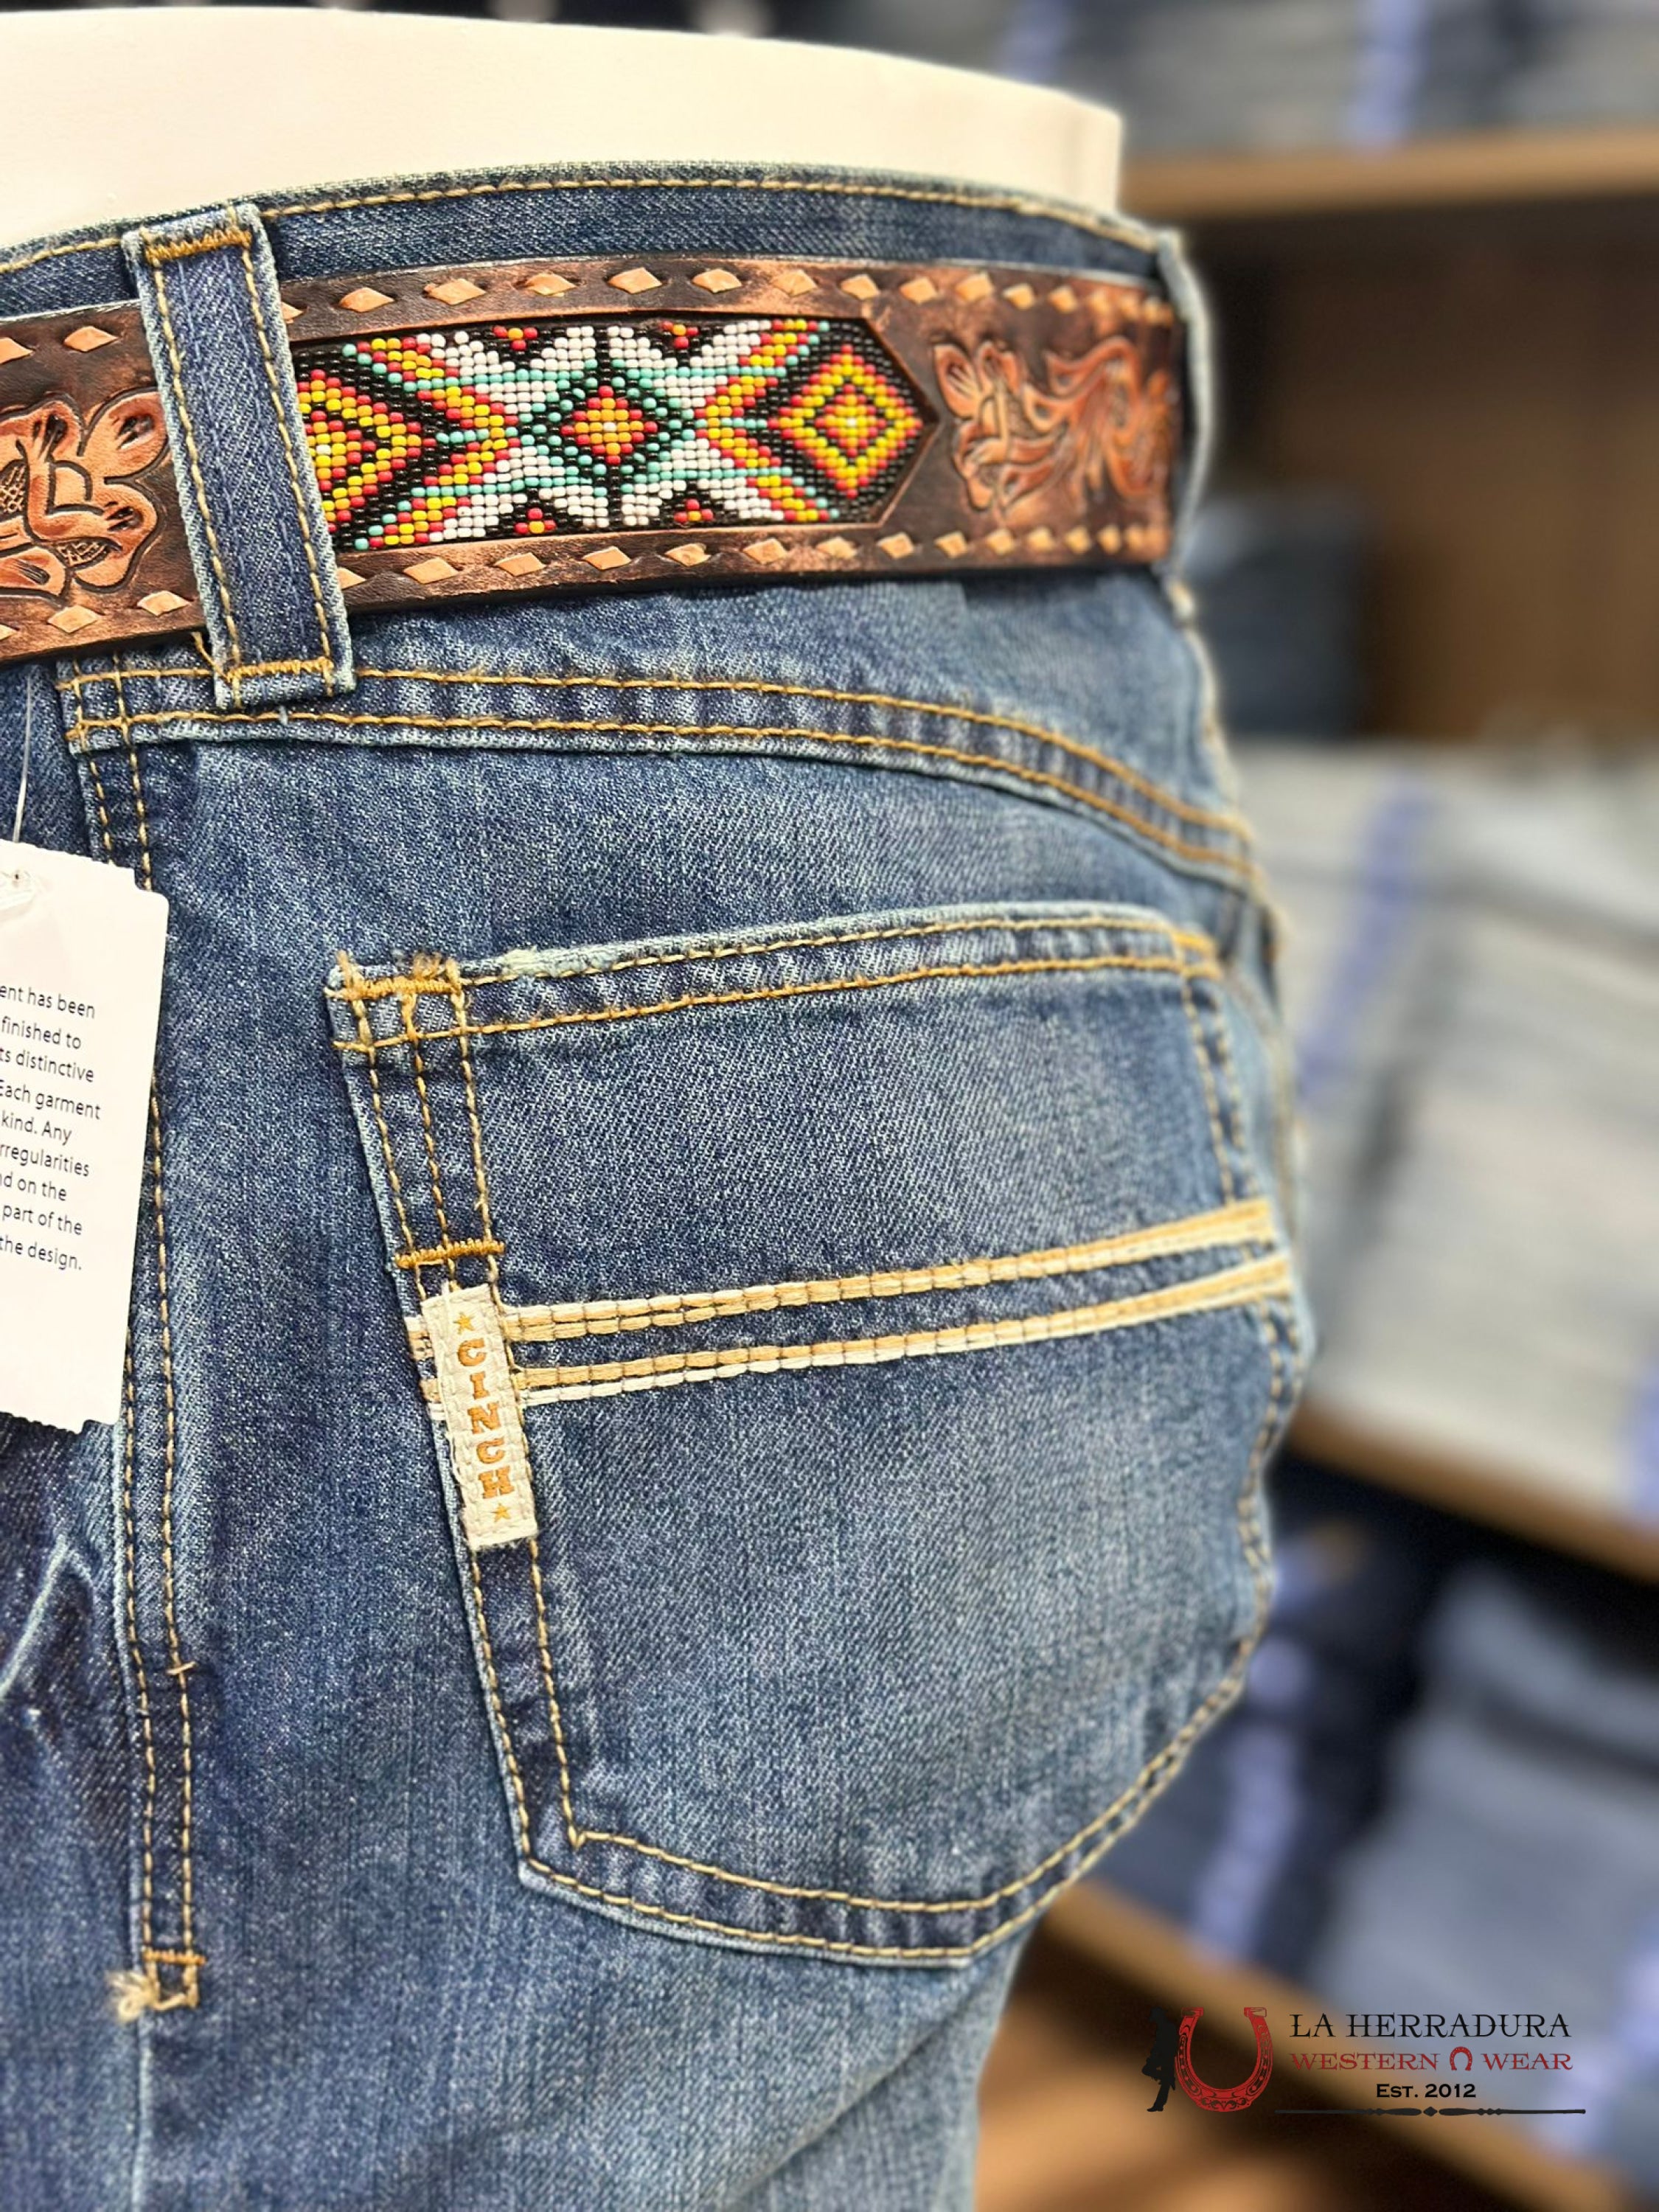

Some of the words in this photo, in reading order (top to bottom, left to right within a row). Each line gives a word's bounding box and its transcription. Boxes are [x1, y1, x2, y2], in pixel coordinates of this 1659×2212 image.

[27, 987, 52, 1009] has
[58, 993, 95, 1019] been
[2, 1015, 62, 1045] finished
[66, 1033, 82, 1049] to
[15, 1049, 94, 1082] distinctive
[35, 1092, 101, 1120] garment
[1, 1110, 37, 1134] kind.
[41, 1120, 72, 1146] Any
[17, 1178, 36, 1194] on
[41, 1180, 66, 1201] the
[2, 1204, 33, 1224] part
[38, 1211, 55, 1228] of
[58, 1214, 83, 1235] the
[0, 1234, 23, 1255] the
[27, 1242, 82, 1270] design.
[456, 1338, 516, 1500] CINCH
